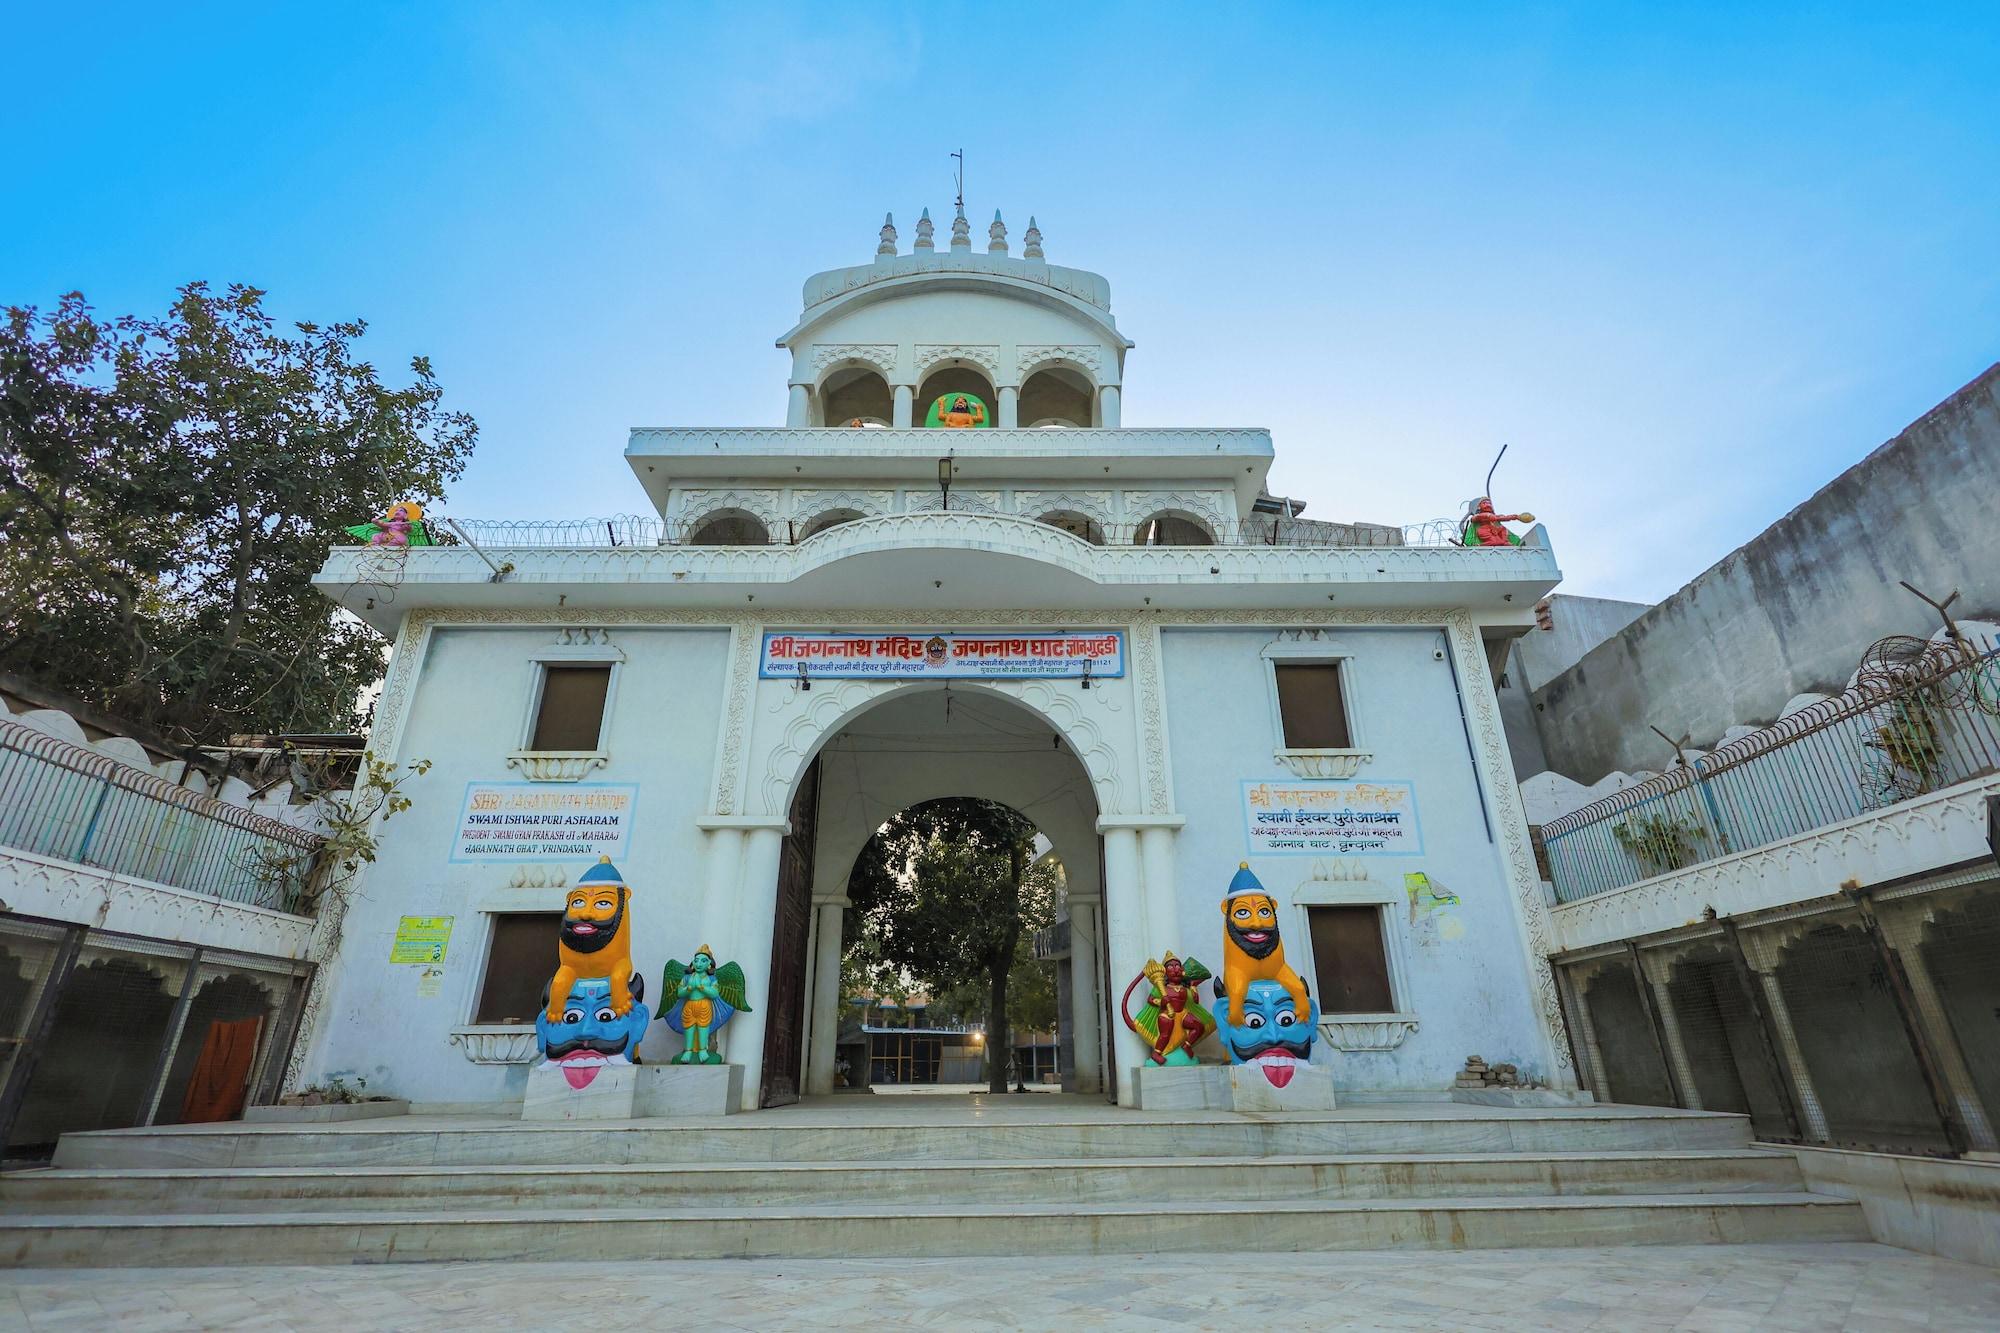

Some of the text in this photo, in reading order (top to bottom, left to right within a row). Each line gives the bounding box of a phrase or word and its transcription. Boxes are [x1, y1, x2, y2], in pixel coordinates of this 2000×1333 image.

[769, 636, 924, 660] श्री जगन्नाथ मंदिर
[952, 639, 1029, 657] जगन्नाथ
[1030, 639, 1065, 657] घाट
[468, 815, 619, 826] SWAMI ISHVAR PURI ASHARAM
[1257, 809, 1400, 827] स्वामी ईश्वर पुरी आश्रम
[532, 830, 565, 840] PRAKASH
[566, 830, 576, 840] JI
[577, 831, 619, 841] MAHARAJ
[464, 844, 515, 854] JAGANNATH
[516, 844, 538, 853] GHAT
